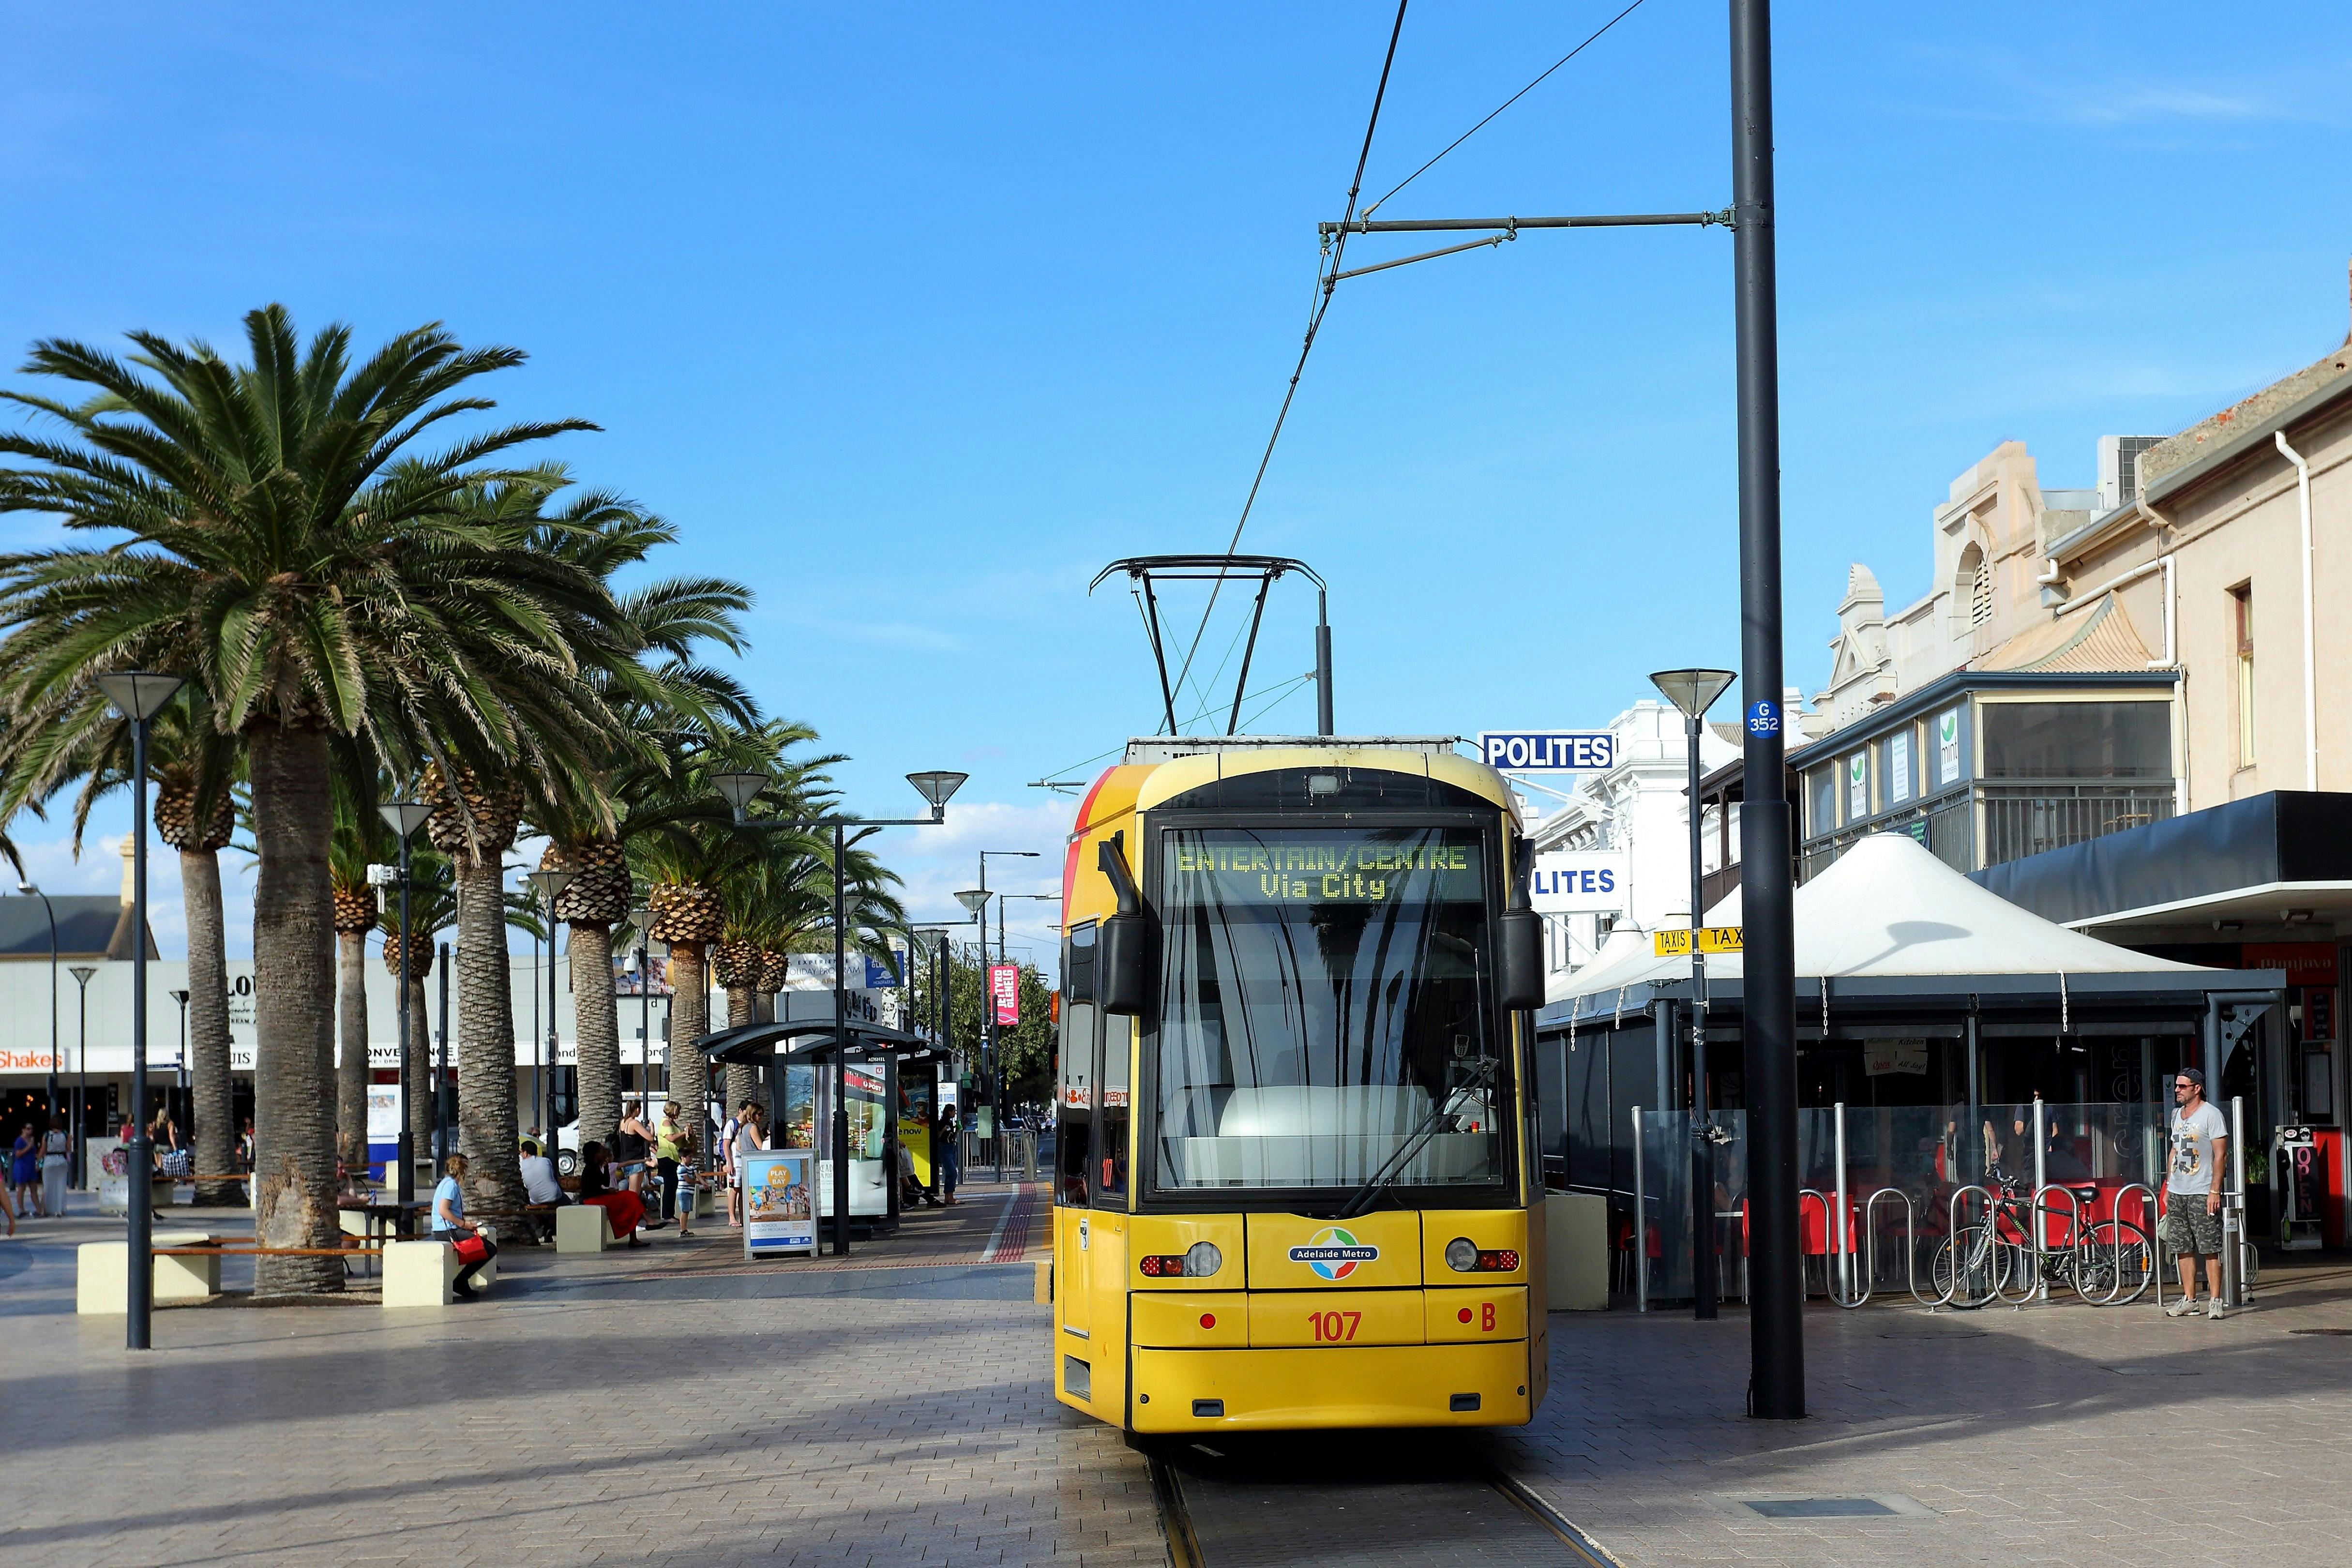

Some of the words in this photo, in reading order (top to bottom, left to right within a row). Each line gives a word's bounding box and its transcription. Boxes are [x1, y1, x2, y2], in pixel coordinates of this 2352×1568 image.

[1759, 703, 1769, 716] G
[1750, 718, 1778, 731] 352
[1488, 737, 1611, 767] POLITES
[1942, 736, 1958, 765] mint
[1852, 776, 1865, 801] mint
[1261, 874, 1307, 898] Via
[1322, 873, 1385, 900] City
[1530, 869, 1614, 894] LITES
[1660, 932, 1686, 949] TAXIS
[1711, 928, 1743, 945] TAX
[1002, 969, 1014, 1008] GLENELG
[0, 1050, 62, 1068] Shakes
[1102, 1158, 1113, 1187] 107
[1297, 1250, 1339, 1258] Adelaide
[1342, 1250, 1371, 1258] Metro
[1308, 1311, 1362, 1342] 107
[1481, 1302, 1496, 1332] B
